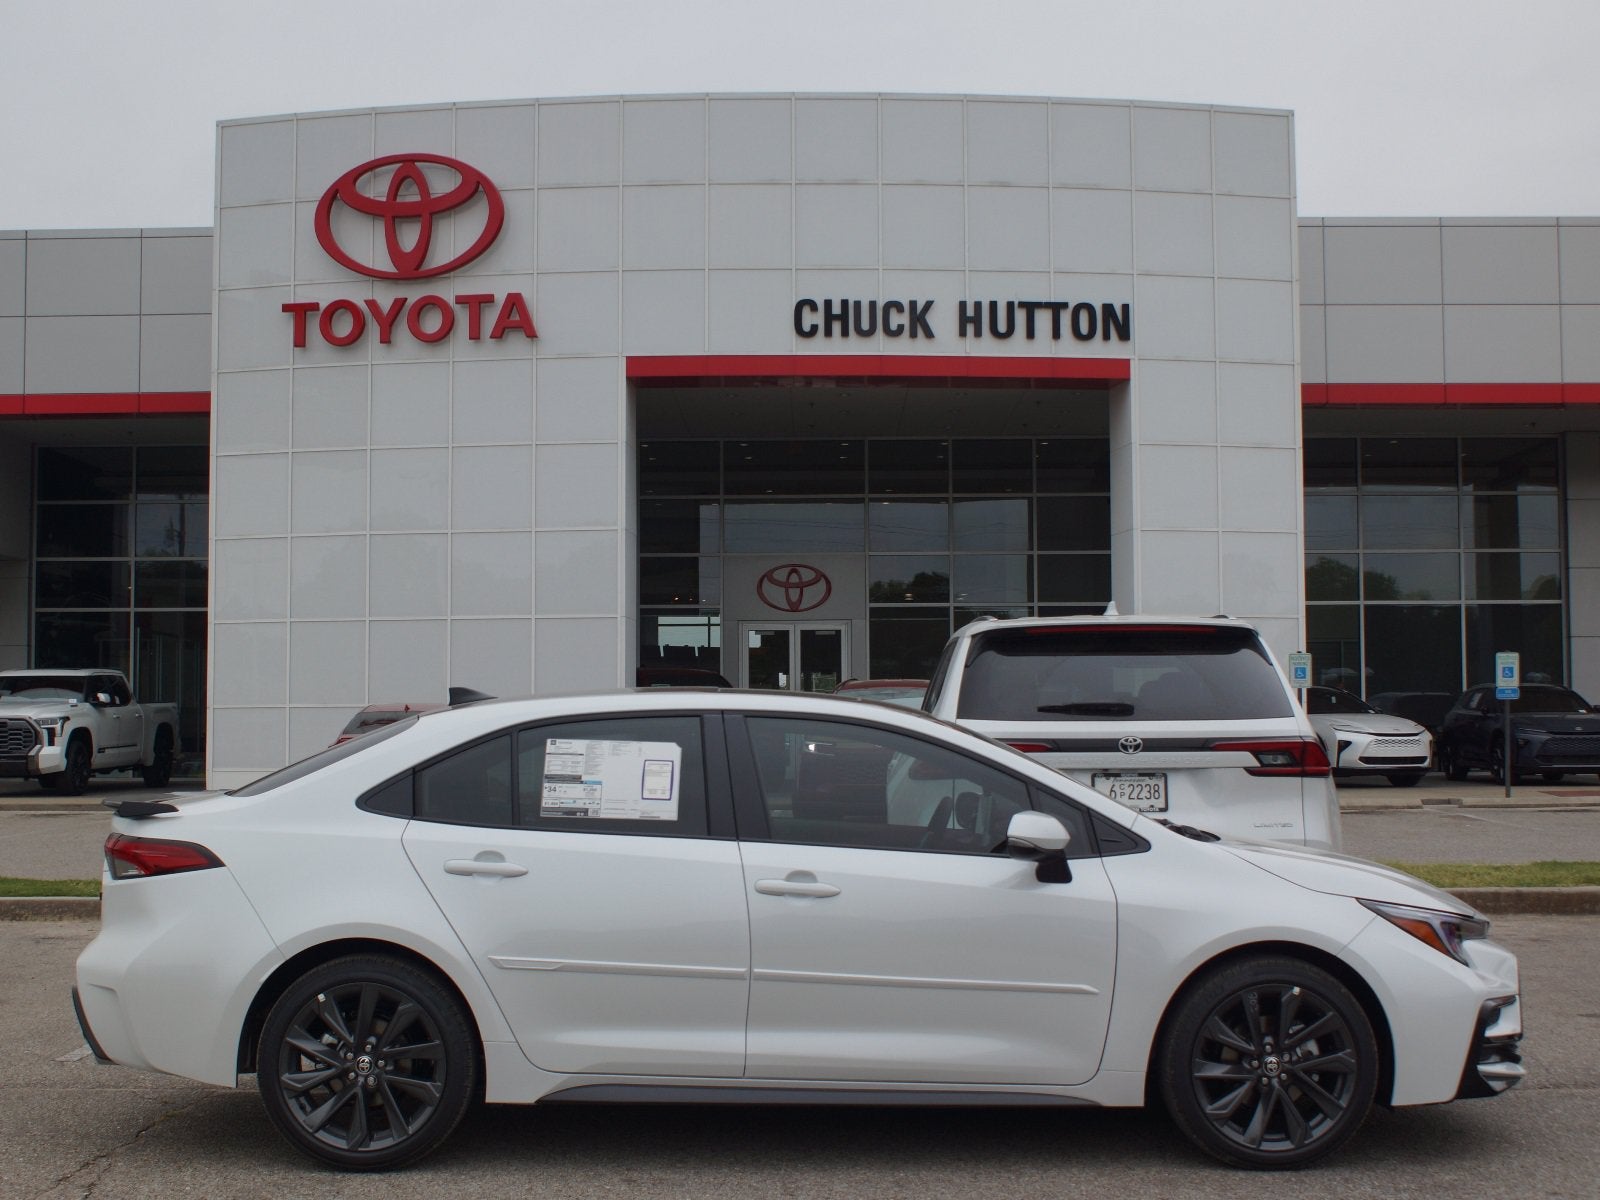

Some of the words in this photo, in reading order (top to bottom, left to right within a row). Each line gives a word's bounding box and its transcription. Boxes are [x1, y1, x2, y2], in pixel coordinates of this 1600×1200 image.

[282, 293, 538, 348] TOYOTA
[793, 298, 936, 339] CHUCK
[958, 300, 1131, 341] HUTTON
